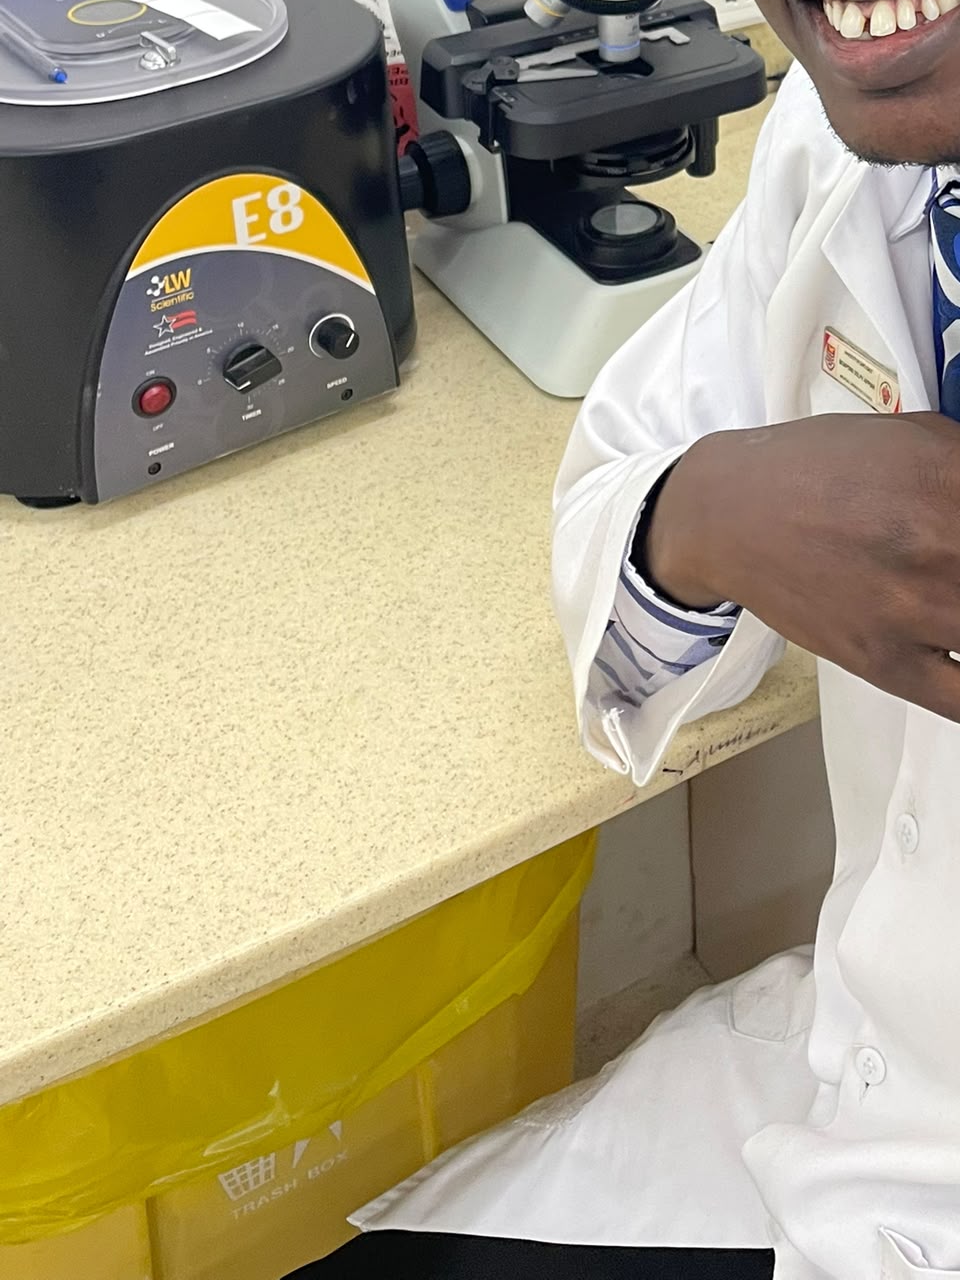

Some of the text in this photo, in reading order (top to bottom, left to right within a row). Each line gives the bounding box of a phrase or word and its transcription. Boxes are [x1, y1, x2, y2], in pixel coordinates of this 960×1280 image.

[231, 182, 304, 246] E8
[164, 268, 192, 294] LW
[150, 290, 195, 312] Scientific
[326, 376, 348, 390] SPEED
[241, 408, 262, 421] TIMER
[148, 441, 175, 457] POWER
[231, 1150, 348, 1220] TRASH BOX
